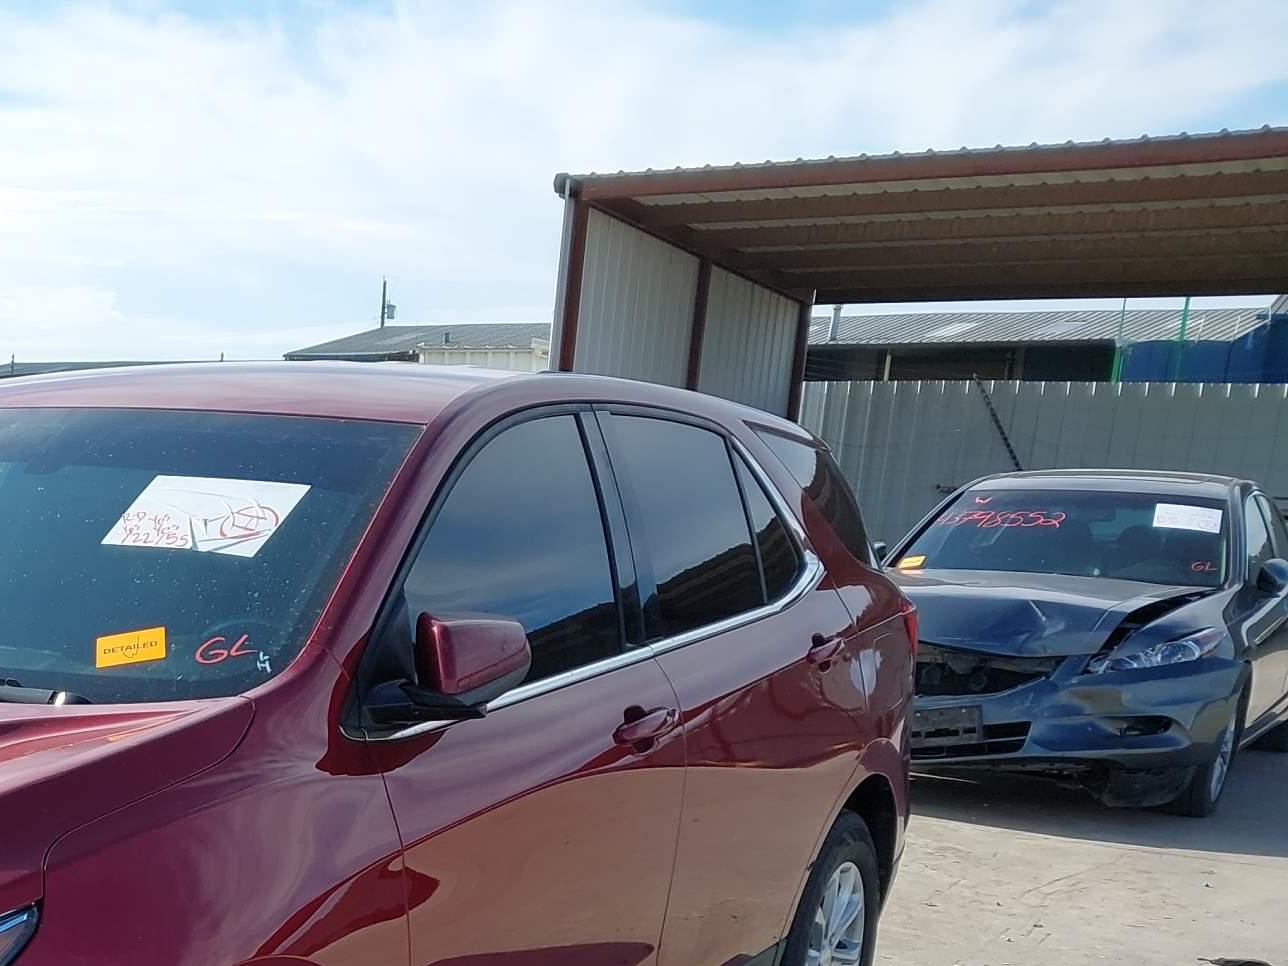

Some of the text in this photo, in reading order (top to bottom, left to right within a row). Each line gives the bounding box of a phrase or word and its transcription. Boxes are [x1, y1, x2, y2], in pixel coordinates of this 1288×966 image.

[1191, 561, 1217, 572] GL
[103, 640, 158, 655] DETAILED
[195, 634, 258, 664] GL
